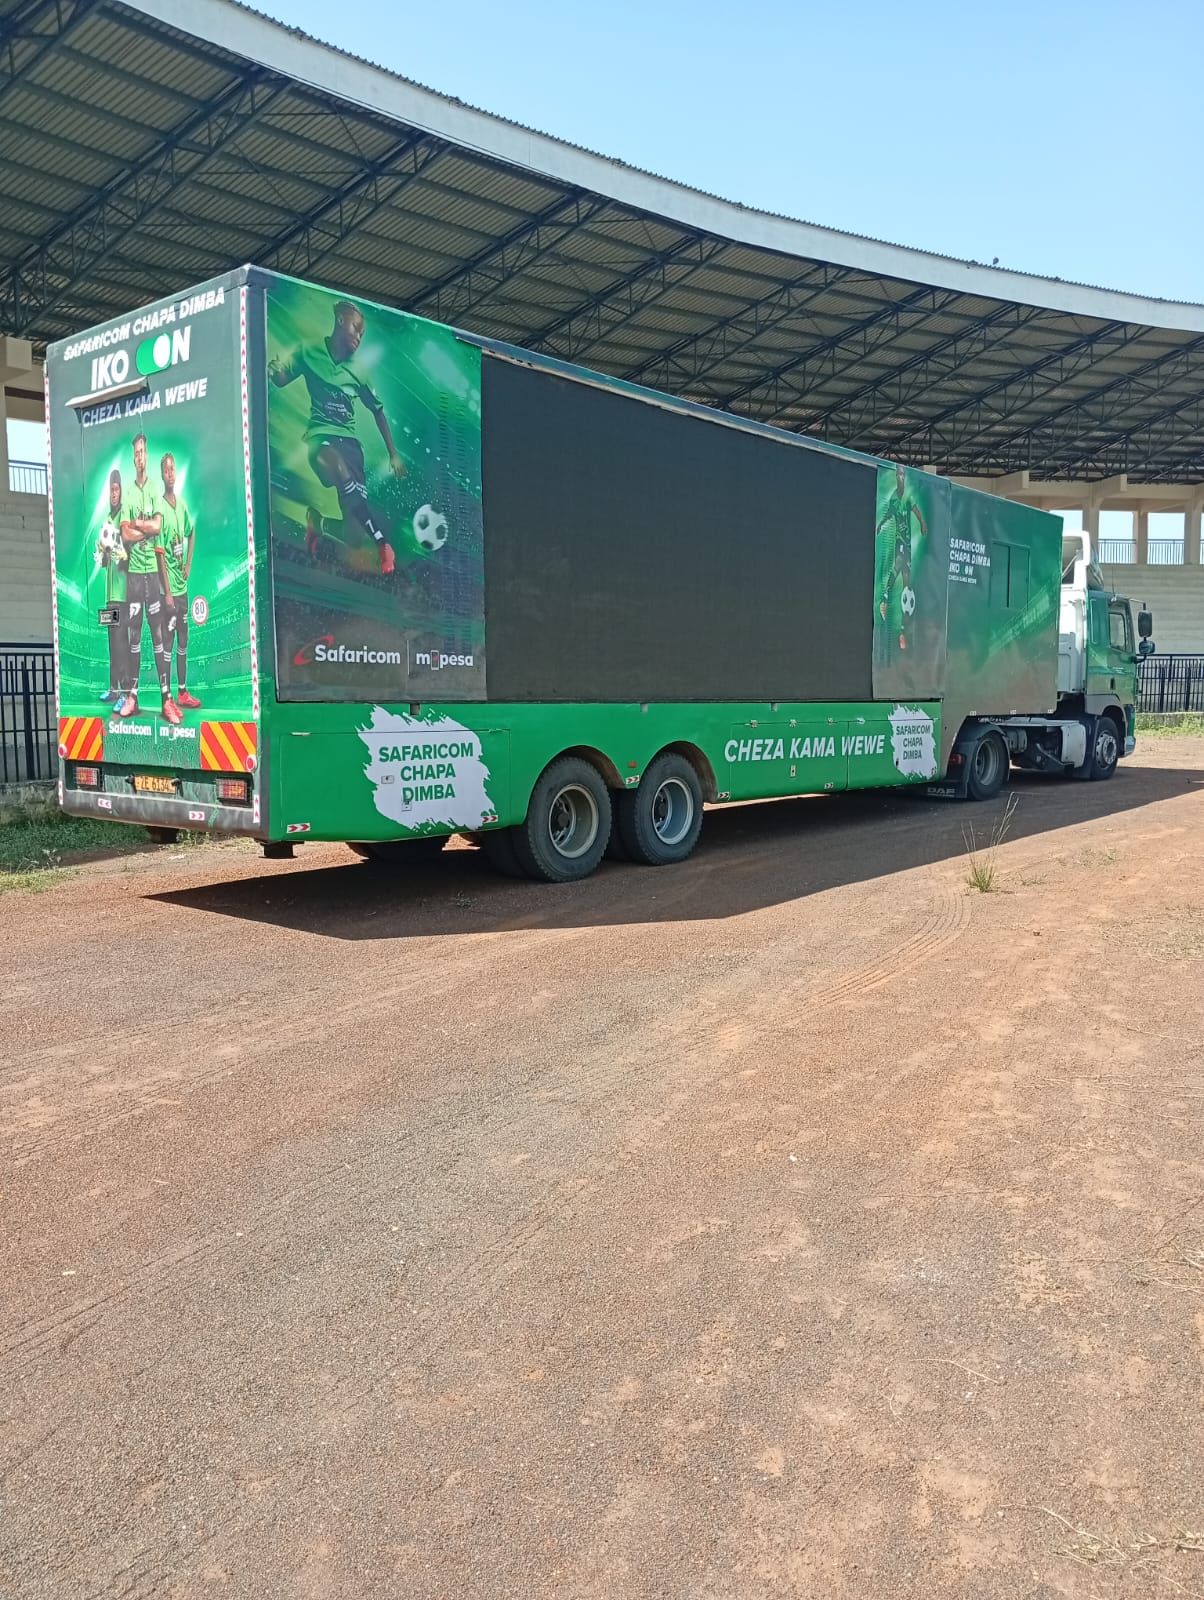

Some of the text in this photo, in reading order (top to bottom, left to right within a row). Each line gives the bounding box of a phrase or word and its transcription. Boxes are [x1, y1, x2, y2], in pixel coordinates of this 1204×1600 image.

[63, 287, 225, 361] SAFARICOM CHAPA DIMBA
[91, 349, 129, 391] IKO
[81, 377, 208, 428] CHEZA KAMA WEWE
[949, 538, 986, 554] SAFARICOM
[949, 550, 991, 567] CHAPA DIMBA
[194, 601, 205, 615] 80
[314, 644, 400, 665] Safaricom
[108, 721, 152, 736] Safaricom
[896, 725, 931, 736] SAFARICOM
[724, 734, 885, 762] CHEZA KAMA WEWE
[902, 737, 923, 748] CHAPA
[378, 742, 474, 763] SAFARICOM
[902, 750, 923, 761] DIMBA
[400, 763, 456, 782] CHAPA
[402, 783, 456, 802] DIMBA
